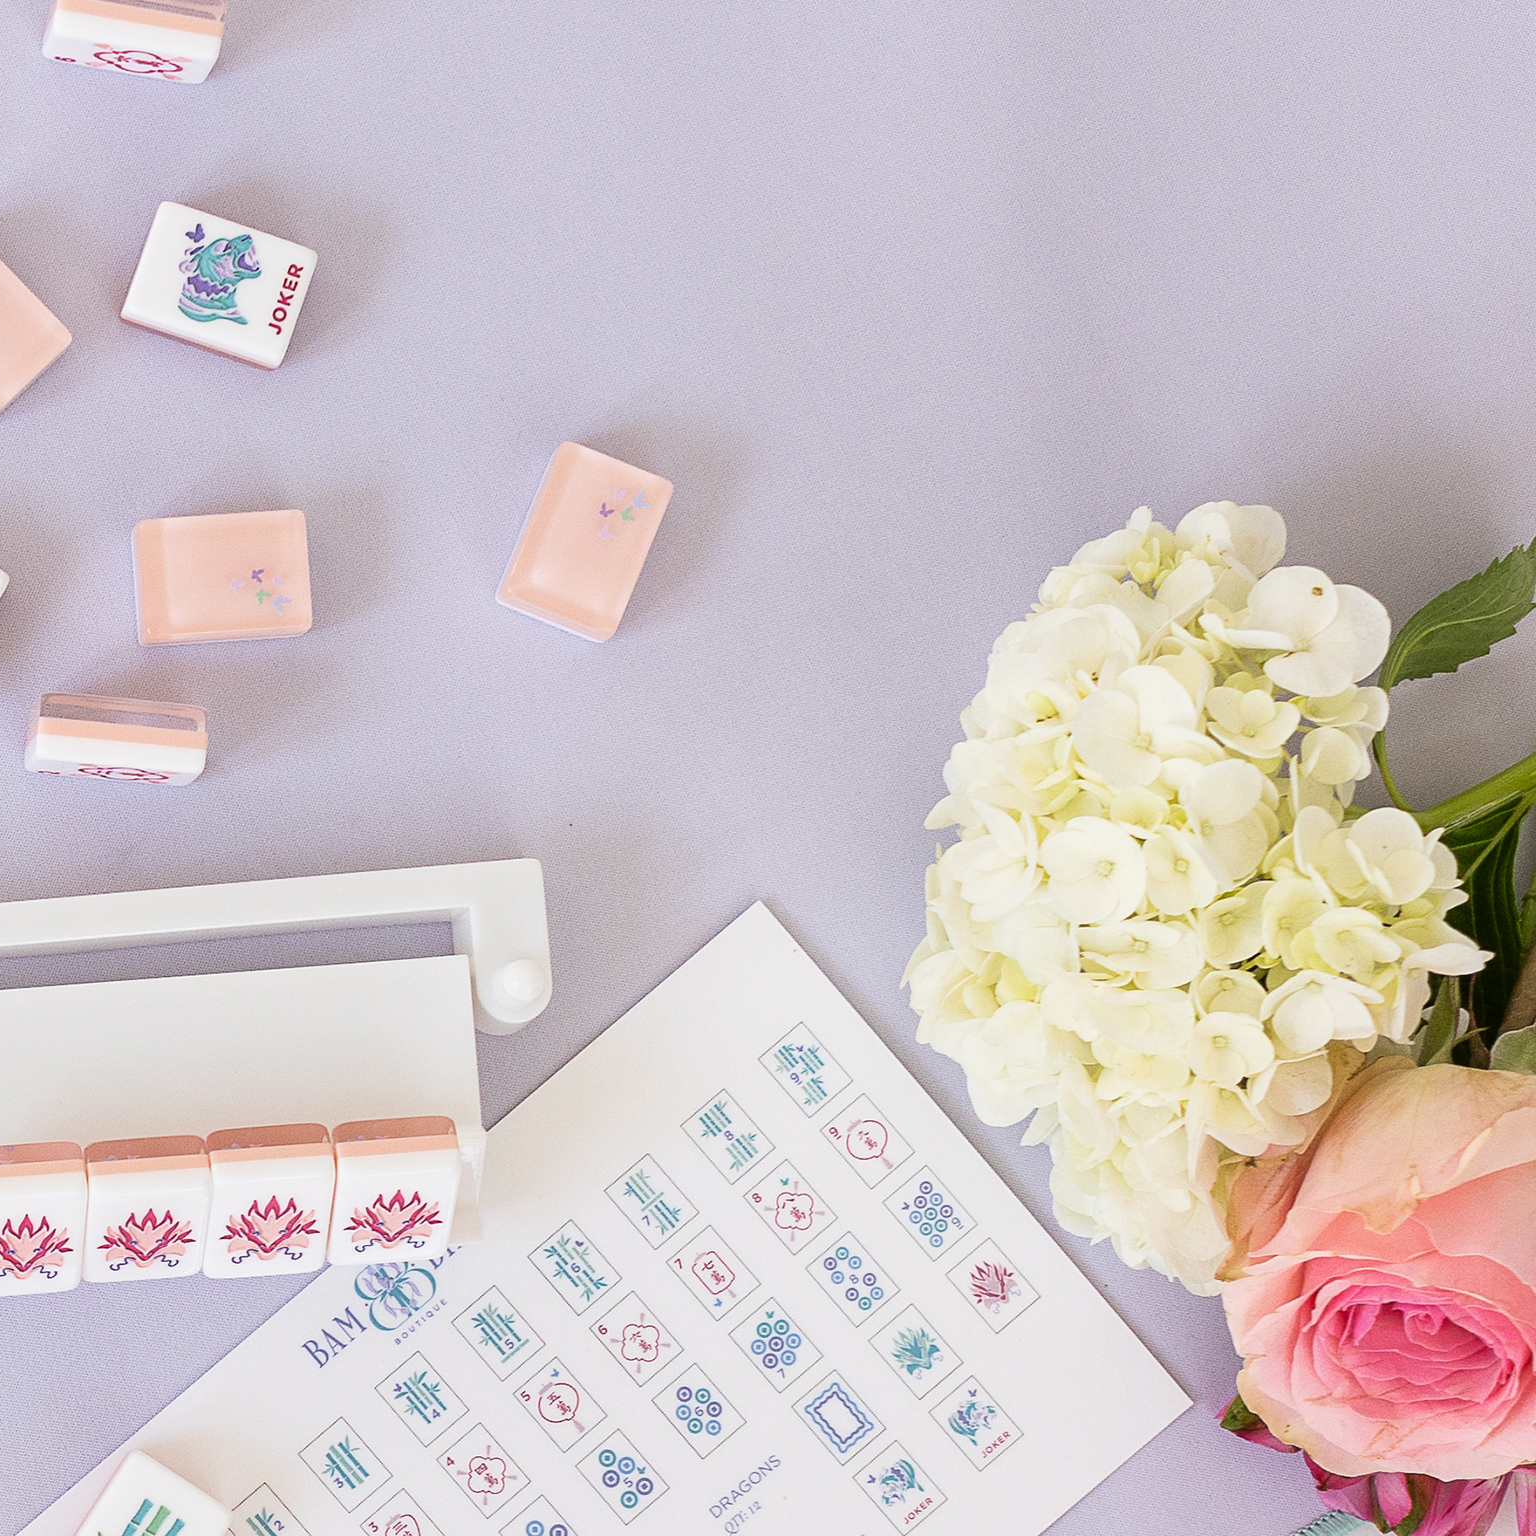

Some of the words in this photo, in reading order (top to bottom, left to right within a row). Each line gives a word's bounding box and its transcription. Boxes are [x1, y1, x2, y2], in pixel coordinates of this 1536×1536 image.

[268, 263, 304, 336] JOKER
[789, 1072, 803, 1086] 9
[723, 1130, 735, 1142] 8
[828, 1126, 842, 1141] 9
[751, 1192, 763, 1204] 8
[641, 1214, 651, 1227] 7
[950, 1216, 965, 1231] 9
[570, 1262, 581, 1274] 6
[673, 1258, 683, 1270] 7
[848, 1273, 860, 1285] 8
[393, 1298, 447, 1346] BOUTIQUE
[597, 1324, 608, 1336] 6
[301, 1306, 368, 1369] BAM
[504, 1338, 515, 1350] 5
[776, 1367, 786, 1379] 7
[520, 1390, 531, 1402] 5
[432, 1408, 441, 1419] 4
[694, 1406, 705, 1417] 6
[981, 1431, 1011, 1459] JOKER
[446, 1456, 455, 1467] 4
[333, 1477, 344, 1489] 3
[622, 1476, 634, 1489] 5
[708, 1454, 781, 1519] DRAGONS
[904, 1497, 933, 1525] JOKER
[724, 1510, 746, 1536] QTY:
[748, 1500, 762, 1515] 12
[273, 1520, 285, 1532] 2
[368, 1521, 379, 1533] 3
